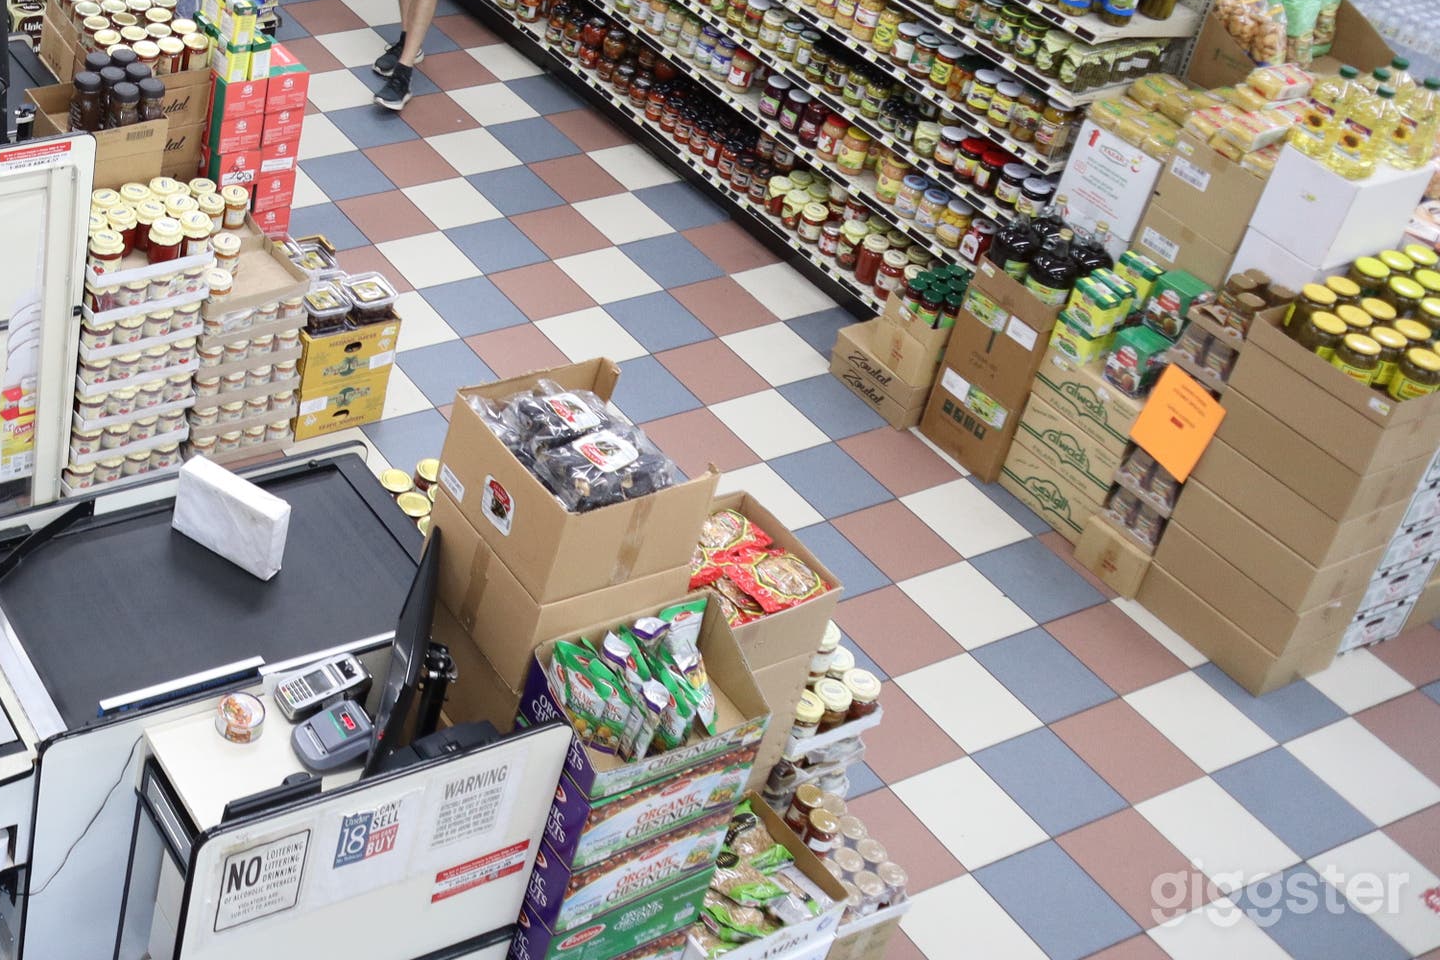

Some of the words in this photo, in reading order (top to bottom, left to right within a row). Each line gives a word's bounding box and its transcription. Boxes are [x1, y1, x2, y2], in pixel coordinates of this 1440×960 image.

[648, 735, 730, 772] CHESTNUTS
[445, 765, 508, 800] WARNING
[345, 814, 369, 827] Under
[372, 810, 399, 830] SELL
[625, 799, 704, 839] CHESTNUTS
[636, 791, 702, 824] ORGANIC
[266, 841, 304, 860] LOITERING
[338, 824, 367, 857] 18
[365, 835, 395, 857] BUY
[226, 856, 262, 894] NO
[262, 866, 297, 883] DRINKING
[264, 854, 300, 871] LITTERING
[616, 852, 681, 888] ORGANIC
[234, 886, 264, 900] ALCOHOLIC
[606, 863, 682, 902] CHESTNUTS
